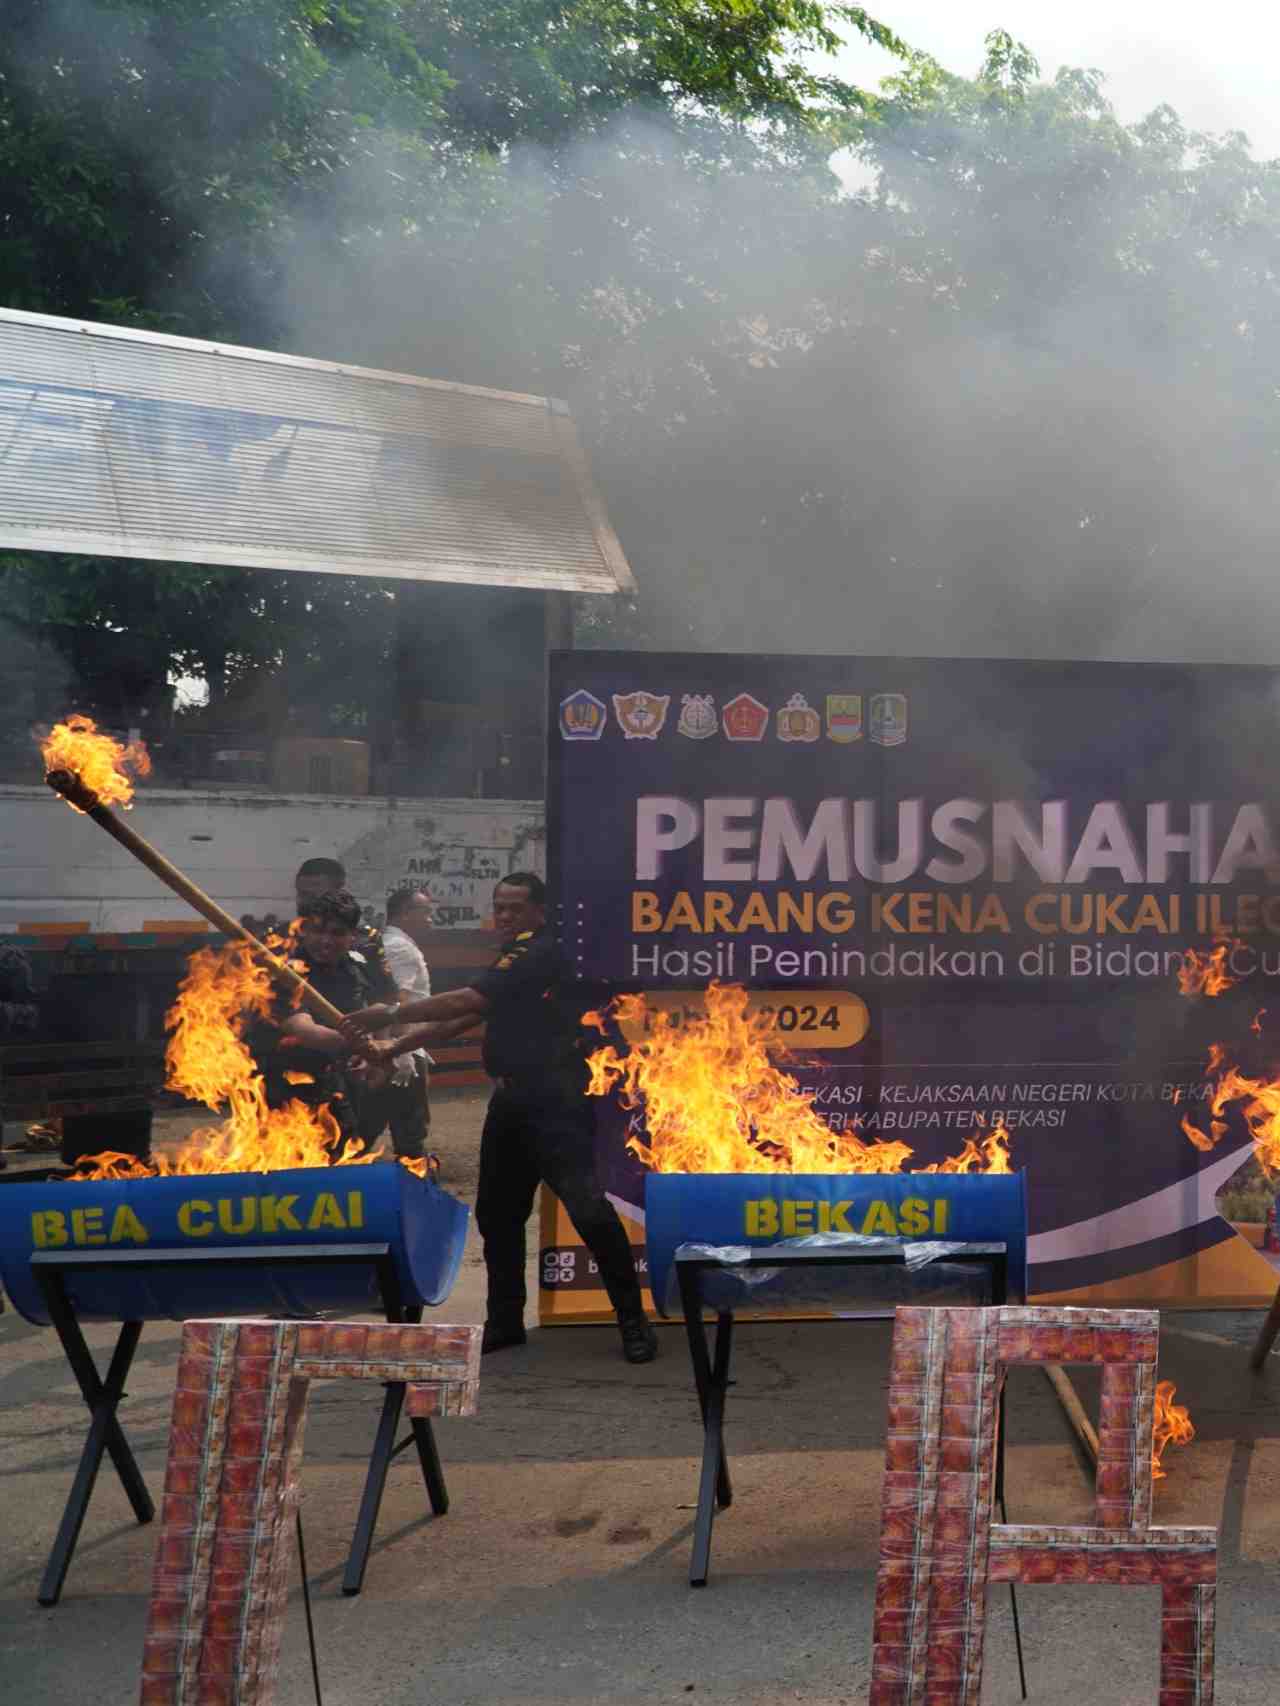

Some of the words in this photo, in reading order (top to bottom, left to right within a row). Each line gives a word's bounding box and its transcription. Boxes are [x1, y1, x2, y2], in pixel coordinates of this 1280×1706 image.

[631, 891, 856, 933] BARANG
[871, 892, 1010, 934] KENA
[1024, 894, 1180, 935] CUKAI
[632, 942, 734, 977] Hasil
[750, 942, 1004, 978] Penindakan
[1018, 944, 1055, 977] di
[1070, 943, 1212, 981] Bidan
[880, 1084, 1007, 1103] KEJAKSAAN
[1011, 1084, 1092, 1102] NEGERI
[1097, 1083, 1155, 1102] KOTA
[853, 1111, 986, 1130] KABUPATEN
[991, 1110, 1067, 1129] BEKASI
[31, 1205, 149, 1249] BEA
[176, 1191, 365, 1238] CUKAI
[744, 1198, 950, 1238] BEKASI
